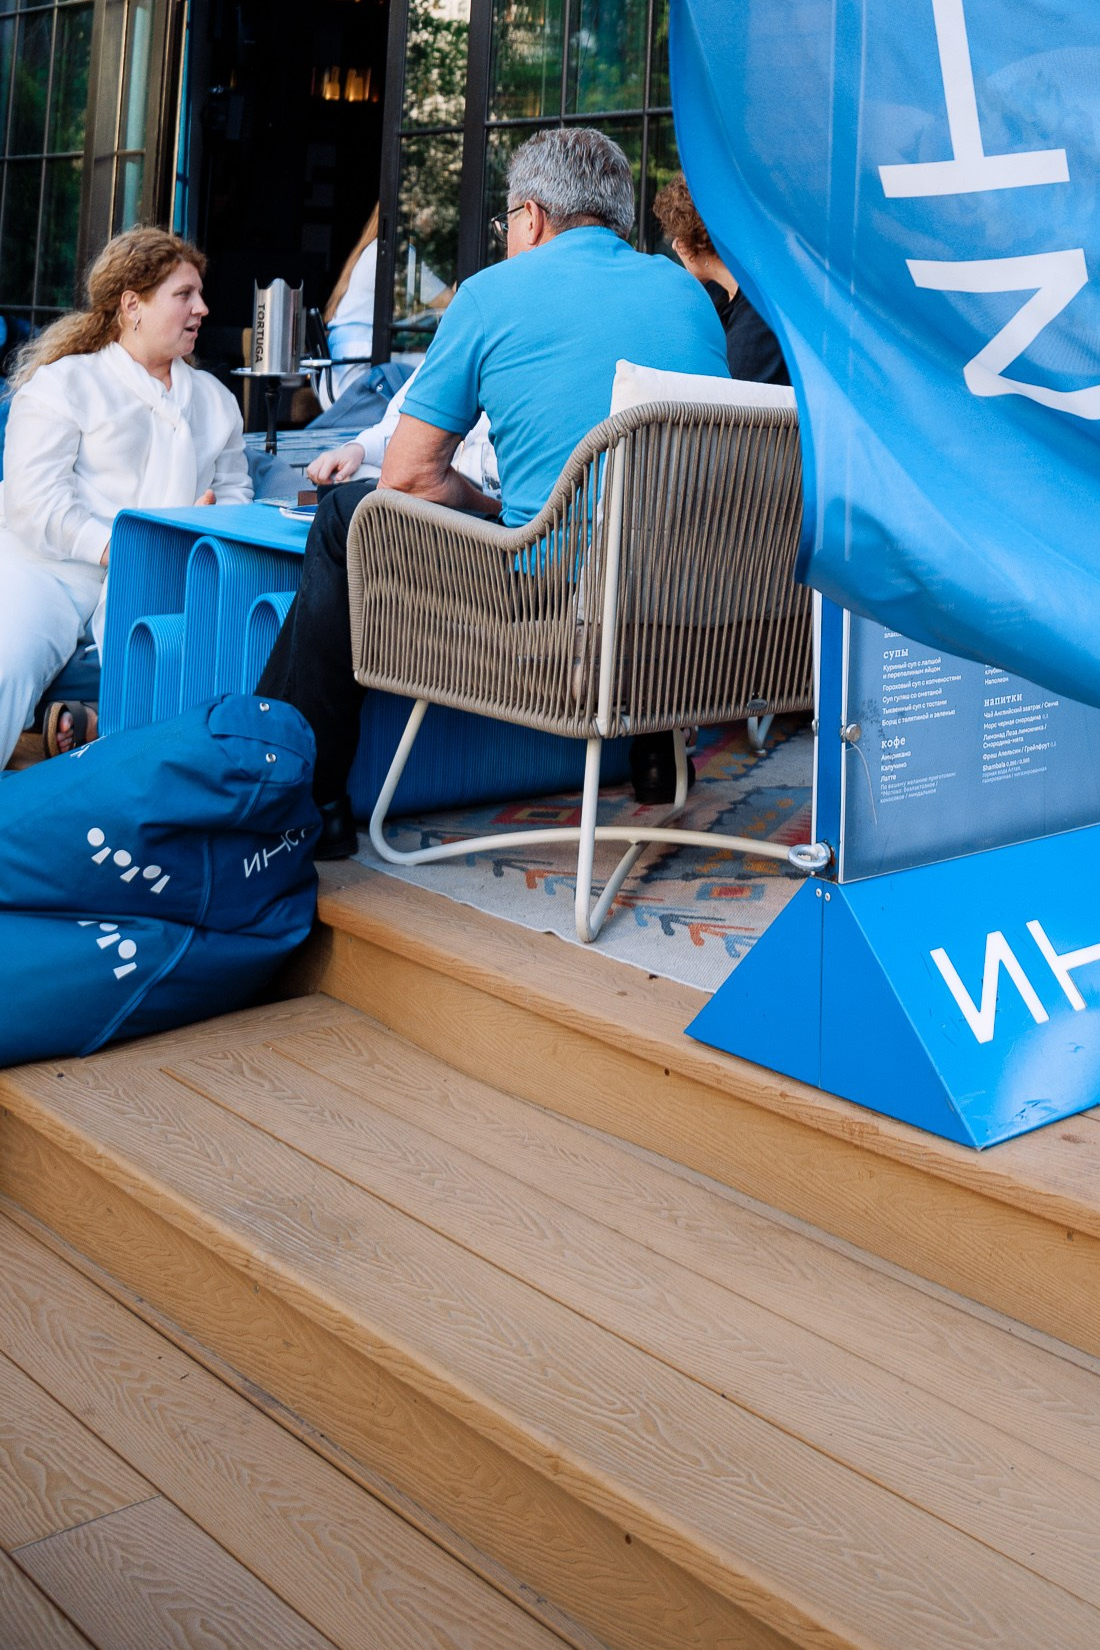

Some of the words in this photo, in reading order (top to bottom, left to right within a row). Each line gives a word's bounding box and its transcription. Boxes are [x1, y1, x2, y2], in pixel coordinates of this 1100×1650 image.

[256, 303, 266, 363] TORTUGA
[883, 649, 909, 660] супы
[883, 661, 906, 672] Куриный
[907, 661, 917, 669] суп
[921, 657, 941, 666] лапшой
[883, 681, 911, 692] Гороховый
[912, 680, 921, 688] суп
[984, 677, 1009, 685] Наполеон
[882, 696, 893, 704] Суп
[918, 687, 942, 698] сметаной
[984, 694, 1022, 707] напитки
[882, 719, 897, 727] Борщ
[881, 735, 906, 749] кофе
[881, 750, 911, 761] Американо
[881, 762, 907, 772] Капучино
